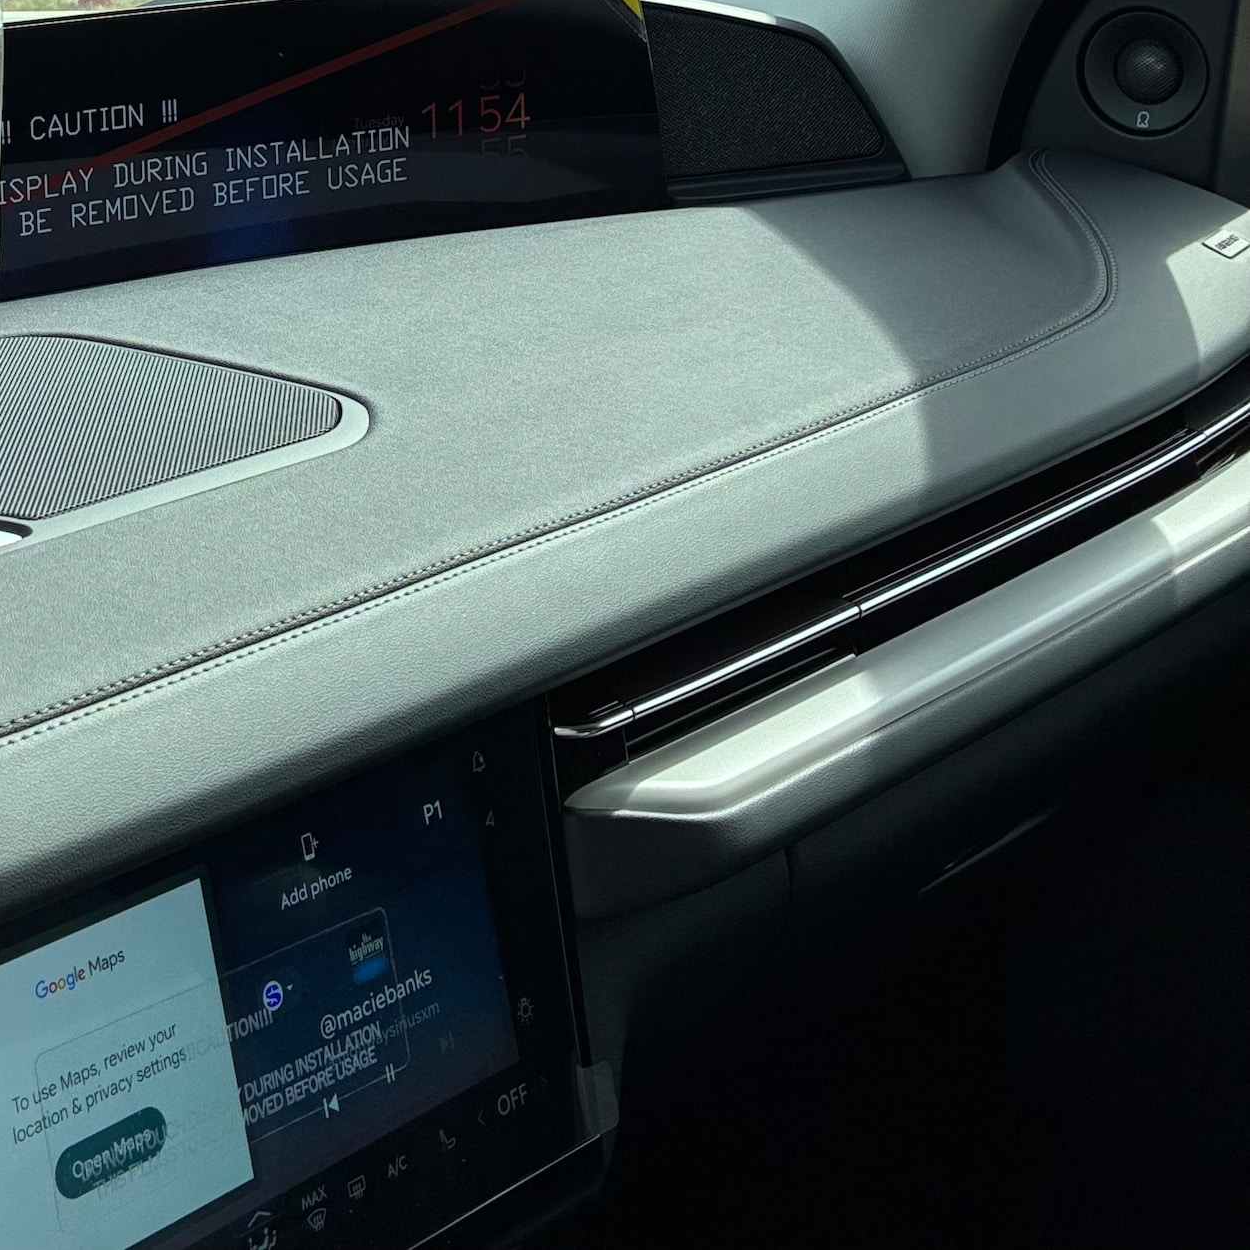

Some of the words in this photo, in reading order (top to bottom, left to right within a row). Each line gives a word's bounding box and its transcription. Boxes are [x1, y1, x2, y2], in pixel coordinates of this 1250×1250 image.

[30, 103, 145, 142] CAUTION
[161, 98, 179, 124] !!!
[113, 151, 209, 190] DURING
[225, 126, 411, 173] INSTALLATION
[18, 208, 53, 239] BE
[70, 187, 196, 229] REMOVED
[213, 170, 311, 209] BEFORE
[326, 156, 408, 192] USAGE
[422, 799, 443, 826] P1
[280, 887, 309, 911] Add
[310, 866, 354, 901] phone
[34, 965, 87, 999] Google
[87, 949, 126, 977] Maps
[348, 935, 385, 964] highway
[319, 967, 434, 1040] @maciebanks
[11, 1096, 30, 1114] To
[32, 1082, 58, 1104] use
[59, 1061, 102, 1092] Maps,
[103, 1041, 146, 1071] review
[148, 1022, 178, 1054] your
[243, 1062, 295, 1104] DURING
[294, 1020, 382, 1078] INSTALLATION
[284, 1069, 336, 1111] BEFORE
[336, 1045, 379, 1082] USAGE
[11, 1106, 69, 1145] location
[71, 1096, 84, 1114] &
[85, 1073, 134, 1113] privacy
[497, 1080, 529, 1118] OFF
[387, 1154, 409, 1179] A/C
[300, 1183, 330, 1212] MAX
